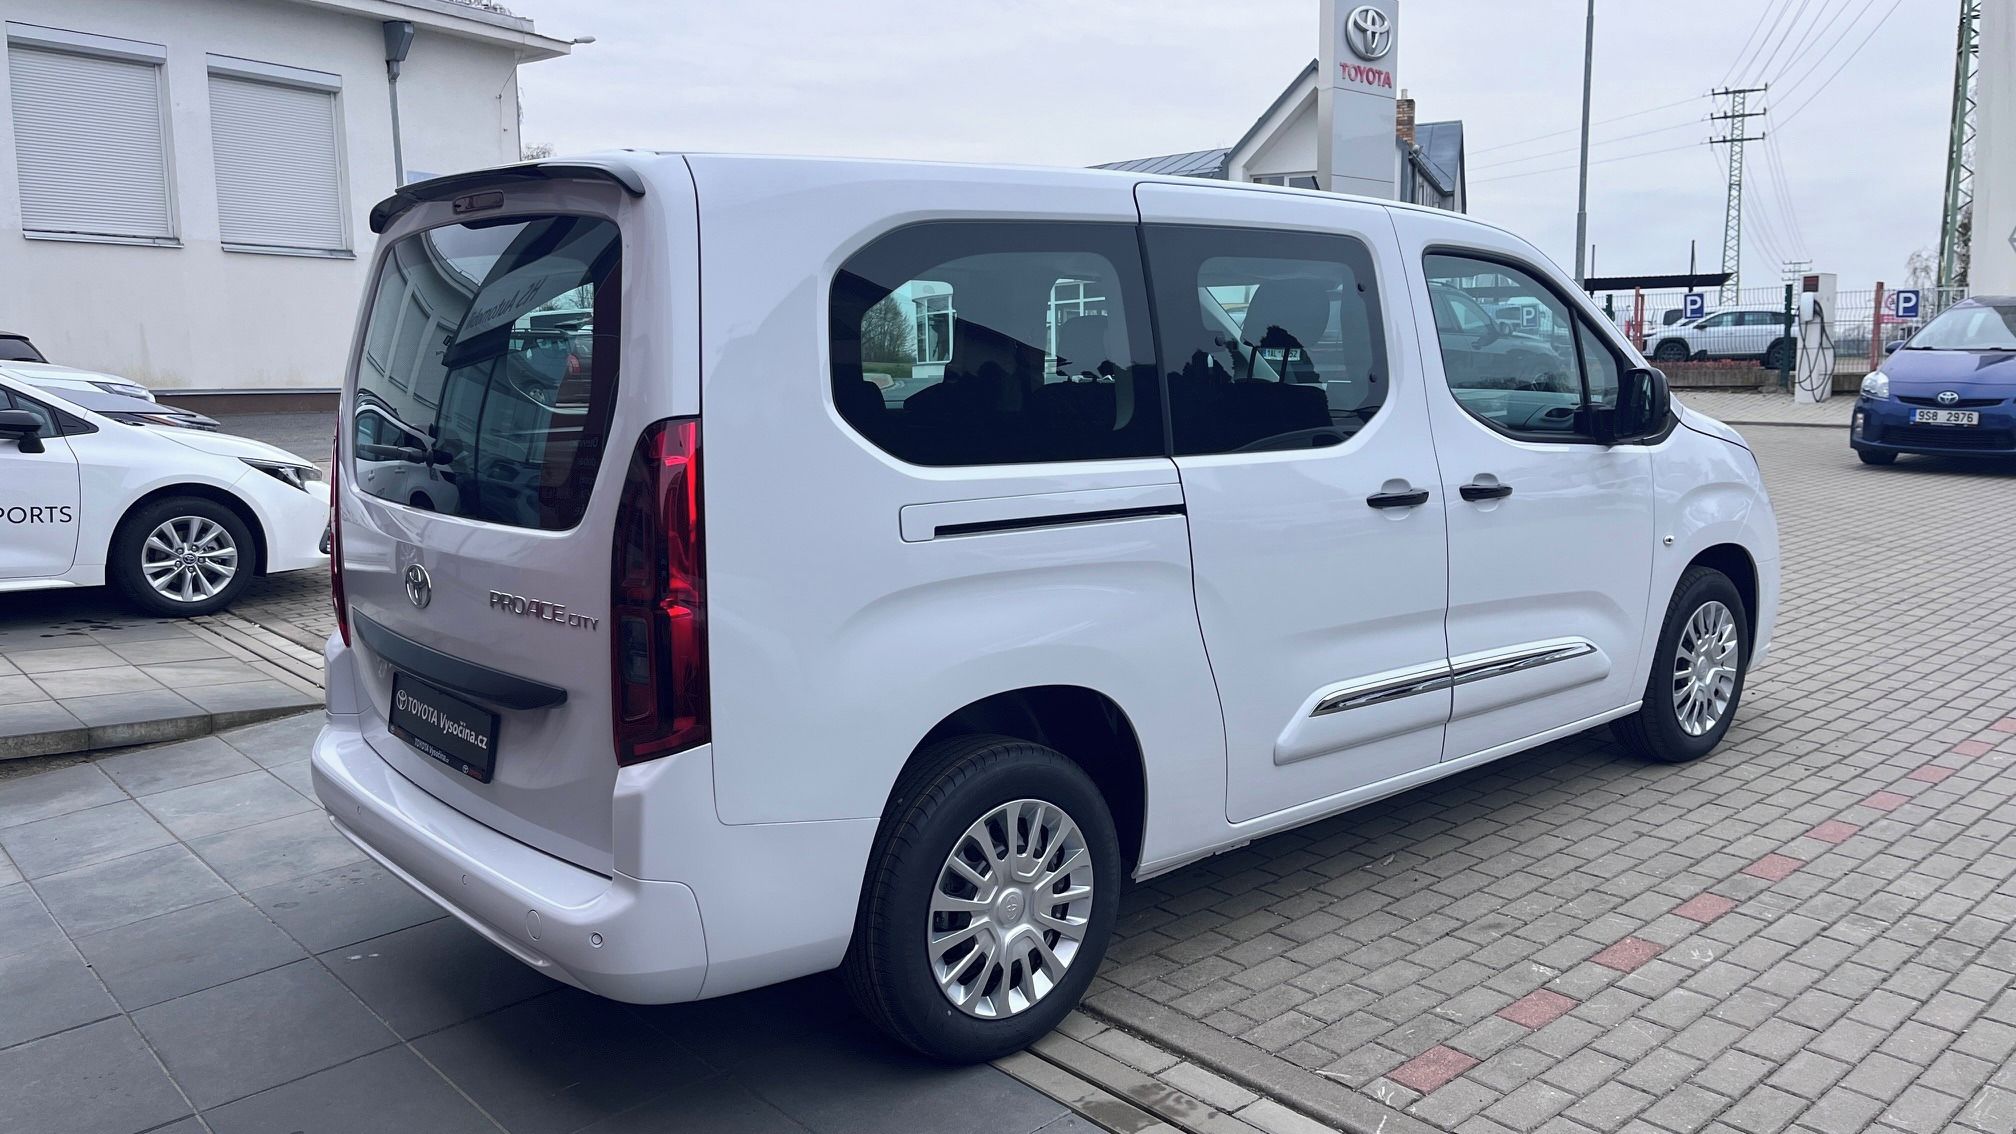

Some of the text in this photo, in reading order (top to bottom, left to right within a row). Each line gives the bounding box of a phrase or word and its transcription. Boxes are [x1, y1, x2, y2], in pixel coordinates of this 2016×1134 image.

[1340, 62, 1393, 89] TOYOTA
[1686, 296, 1702, 317] P
[1898, 292, 1917, 316] P
[1522, 307, 1536, 326] P
[1918, 410, 1974, 423] 9S8 2976
[489, 589, 599, 631] PROACE CITY
[408, 696, 438, 726] TOYOTA
[440, 712, 488, 750] Vysočina.cz
